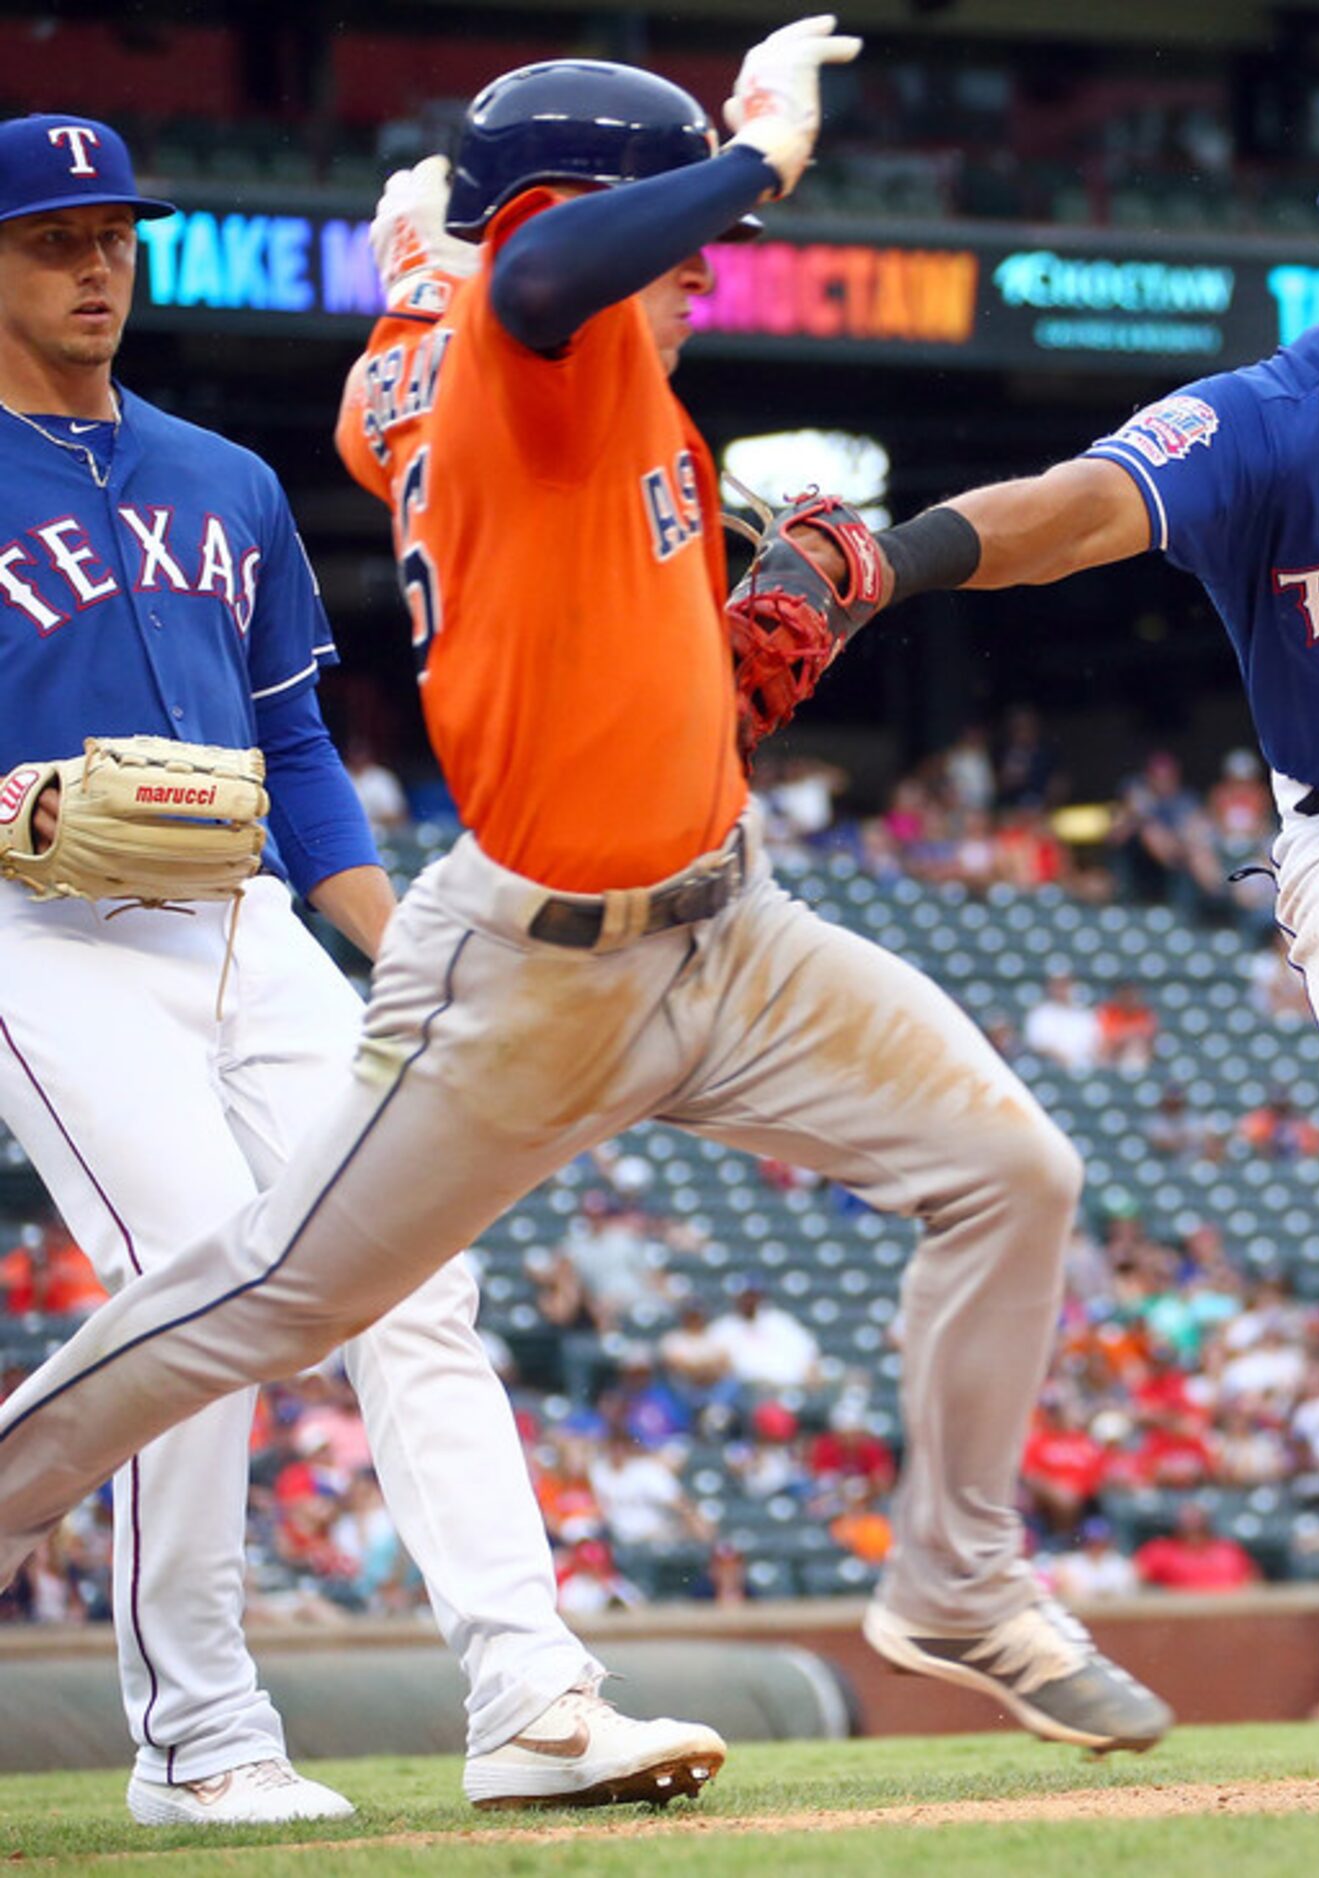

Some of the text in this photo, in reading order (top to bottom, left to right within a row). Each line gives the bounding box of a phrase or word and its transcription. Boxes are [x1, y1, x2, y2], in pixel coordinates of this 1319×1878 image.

[48, 126, 101, 178] T
[137, 210, 314, 312] TAKE
[0, 502, 261, 639] TEXAS
[135, 785, 218, 805] marucci
